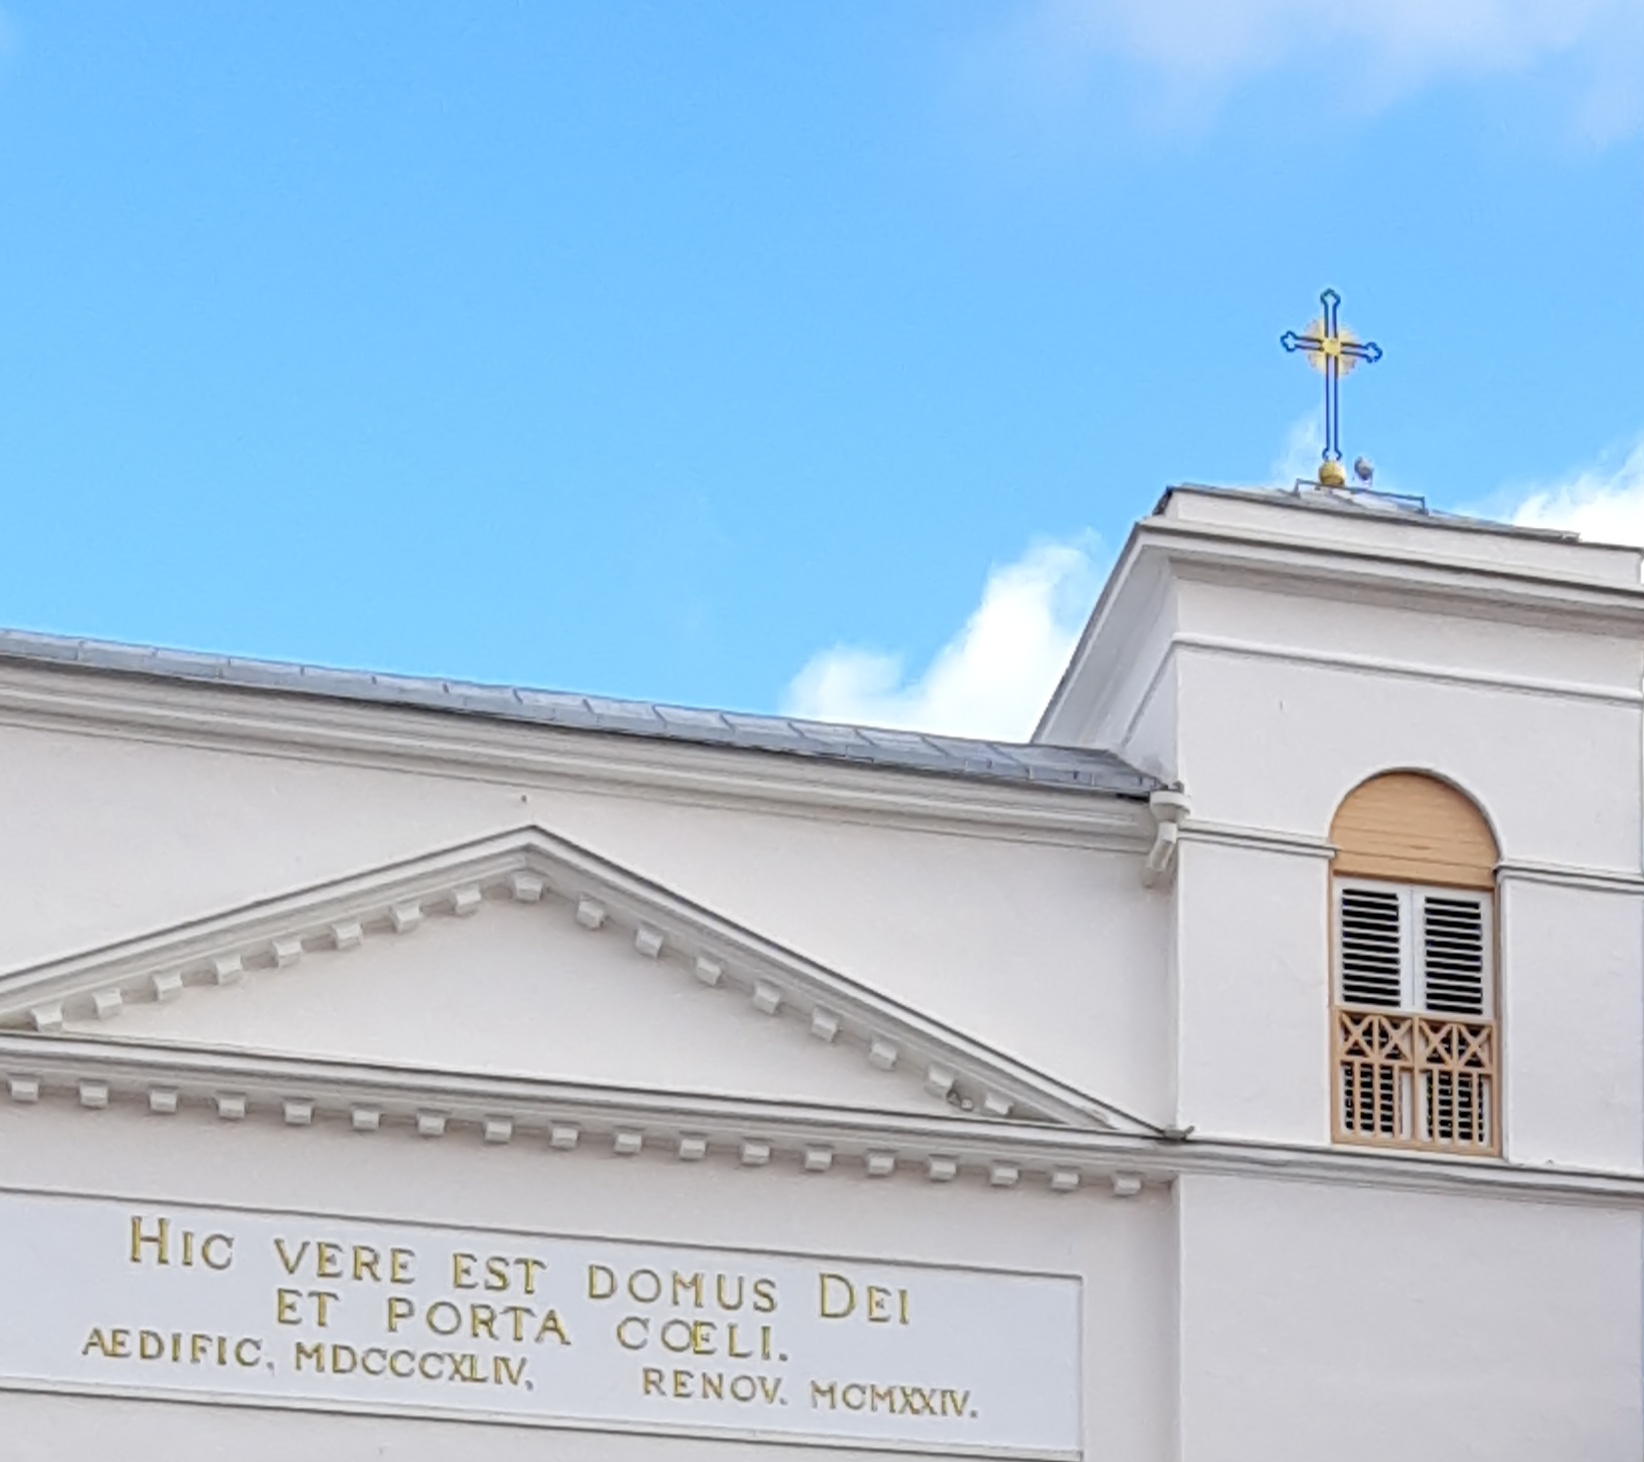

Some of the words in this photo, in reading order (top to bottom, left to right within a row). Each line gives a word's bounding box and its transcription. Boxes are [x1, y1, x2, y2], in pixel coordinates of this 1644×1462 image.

[274, 1239, 416, 1284] VERE
[452, 1253, 547, 1295] EST
[588, 1264, 778, 1313] DOMUS
[277, 1288, 339, 1328] ET
[388, 1298, 572, 1345] PORTA
